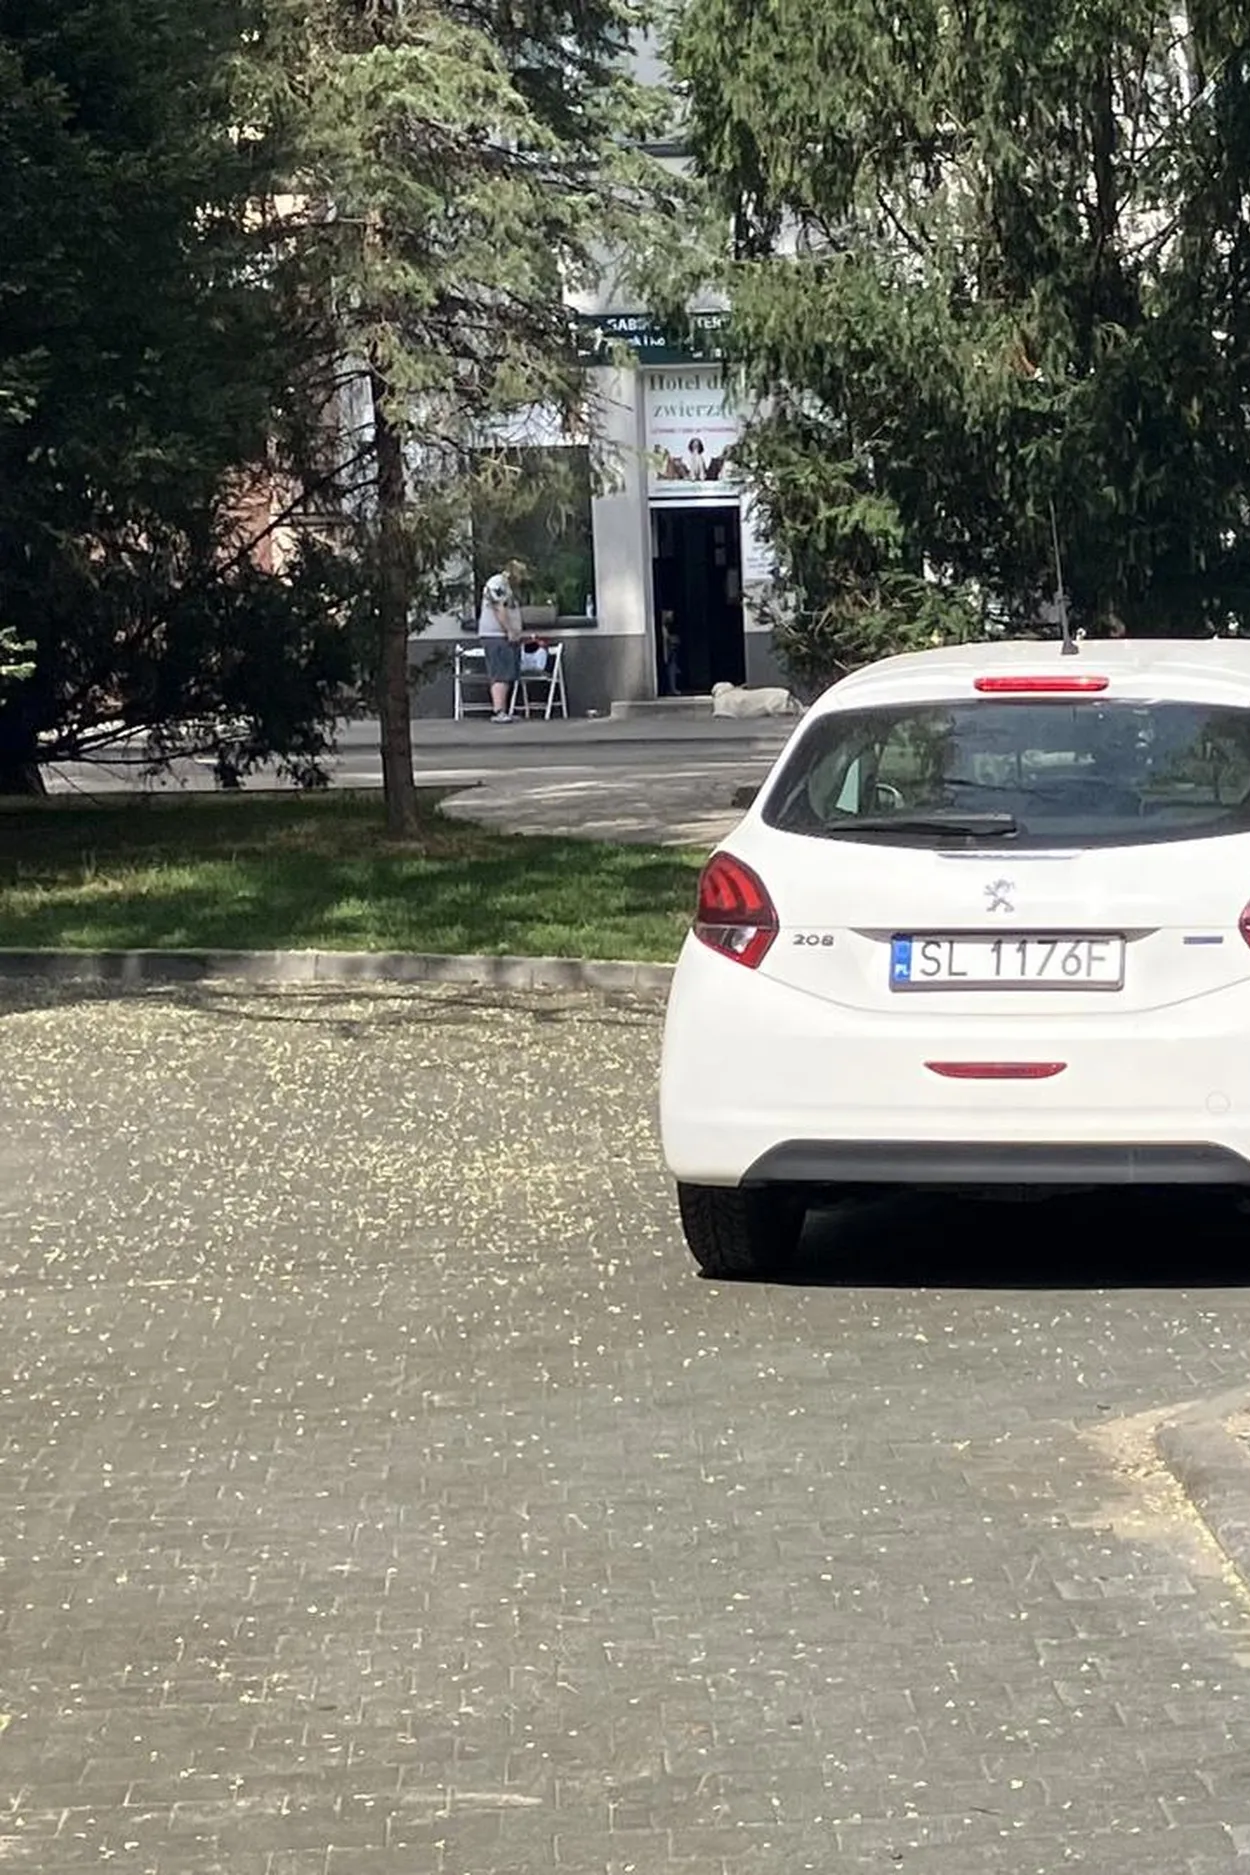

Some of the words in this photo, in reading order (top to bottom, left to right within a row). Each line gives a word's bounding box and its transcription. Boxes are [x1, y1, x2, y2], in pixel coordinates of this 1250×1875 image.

[649, 374, 701, 391] Hotel
[793, 934, 835, 946] 208
[919, 940, 968, 977] SL
[990, 939, 1112, 977] 1176F
[894, 963, 909, 976] PL
